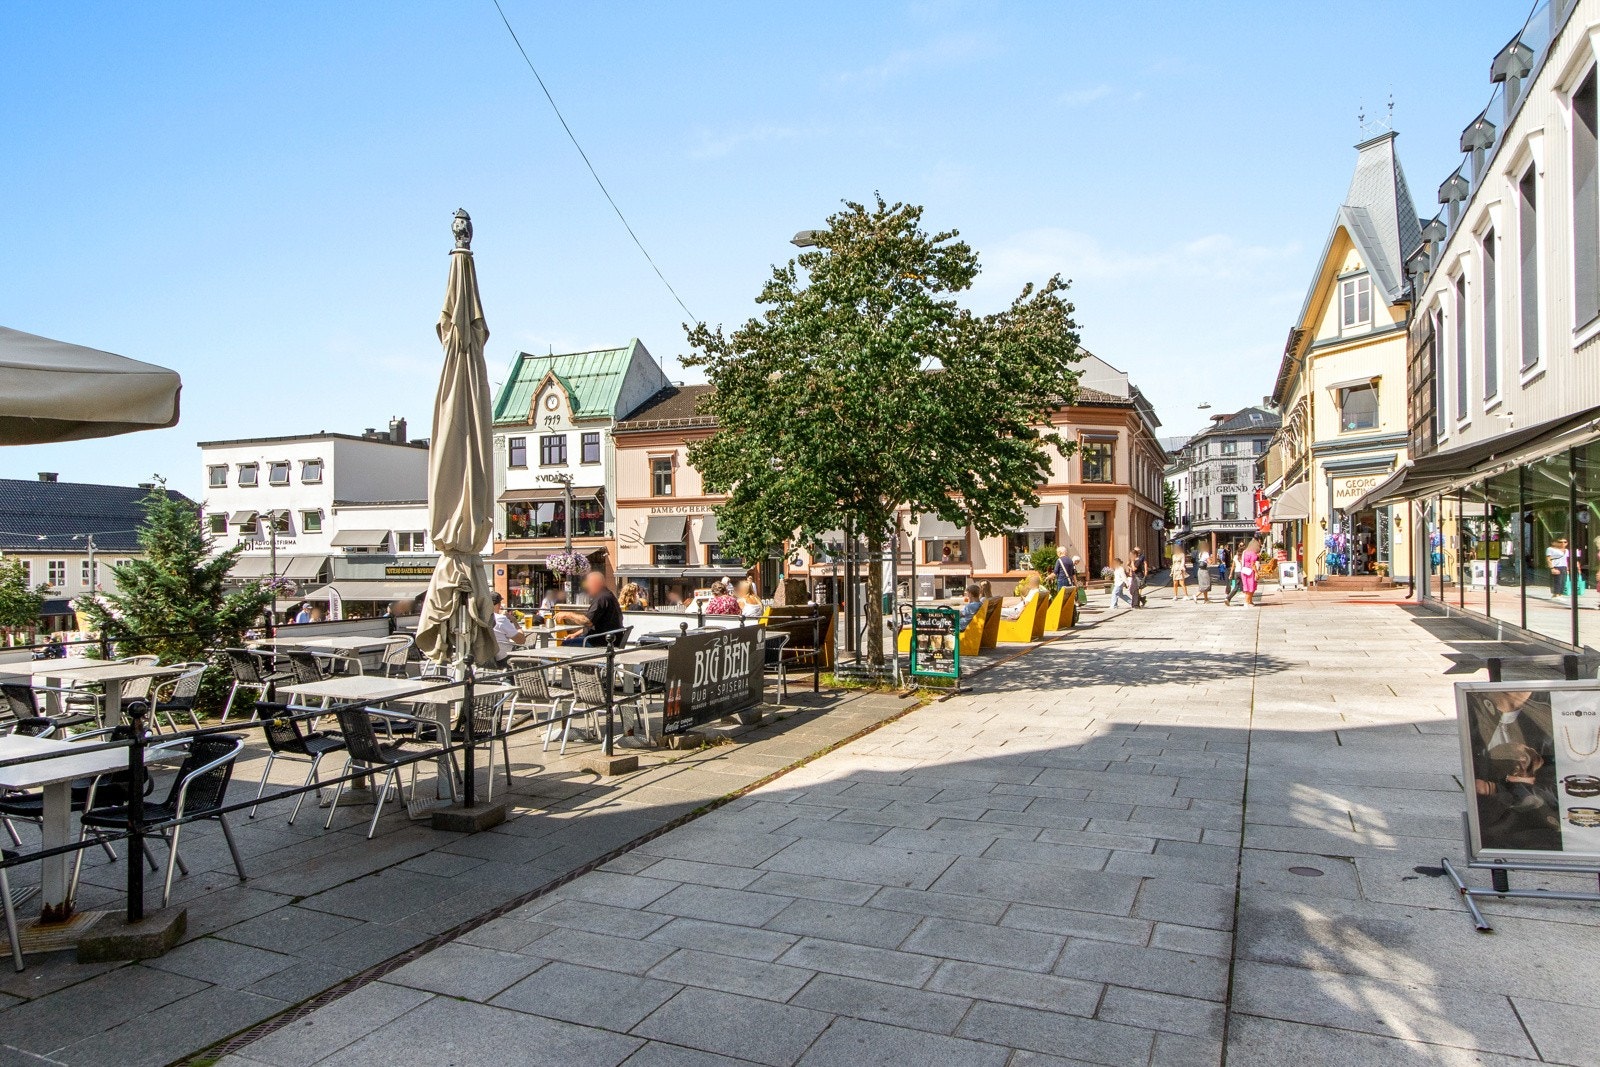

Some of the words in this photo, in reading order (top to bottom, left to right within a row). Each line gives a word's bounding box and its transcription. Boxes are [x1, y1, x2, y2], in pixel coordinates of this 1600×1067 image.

[544, 415, 561, 426] 1919
[540, 473, 569, 482] VIDAS
[1216, 485, 1249, 493] GRAND
[1345, 479, 1377, 489] GEORG
[931, 617, 952, 629] Coffee
[693, 647, 720, 688] BIG
[722, 641, 751, 680] BEN
[691, 689, 707, 703] PUB
[717, 678, 749, 696] SPISERIA
